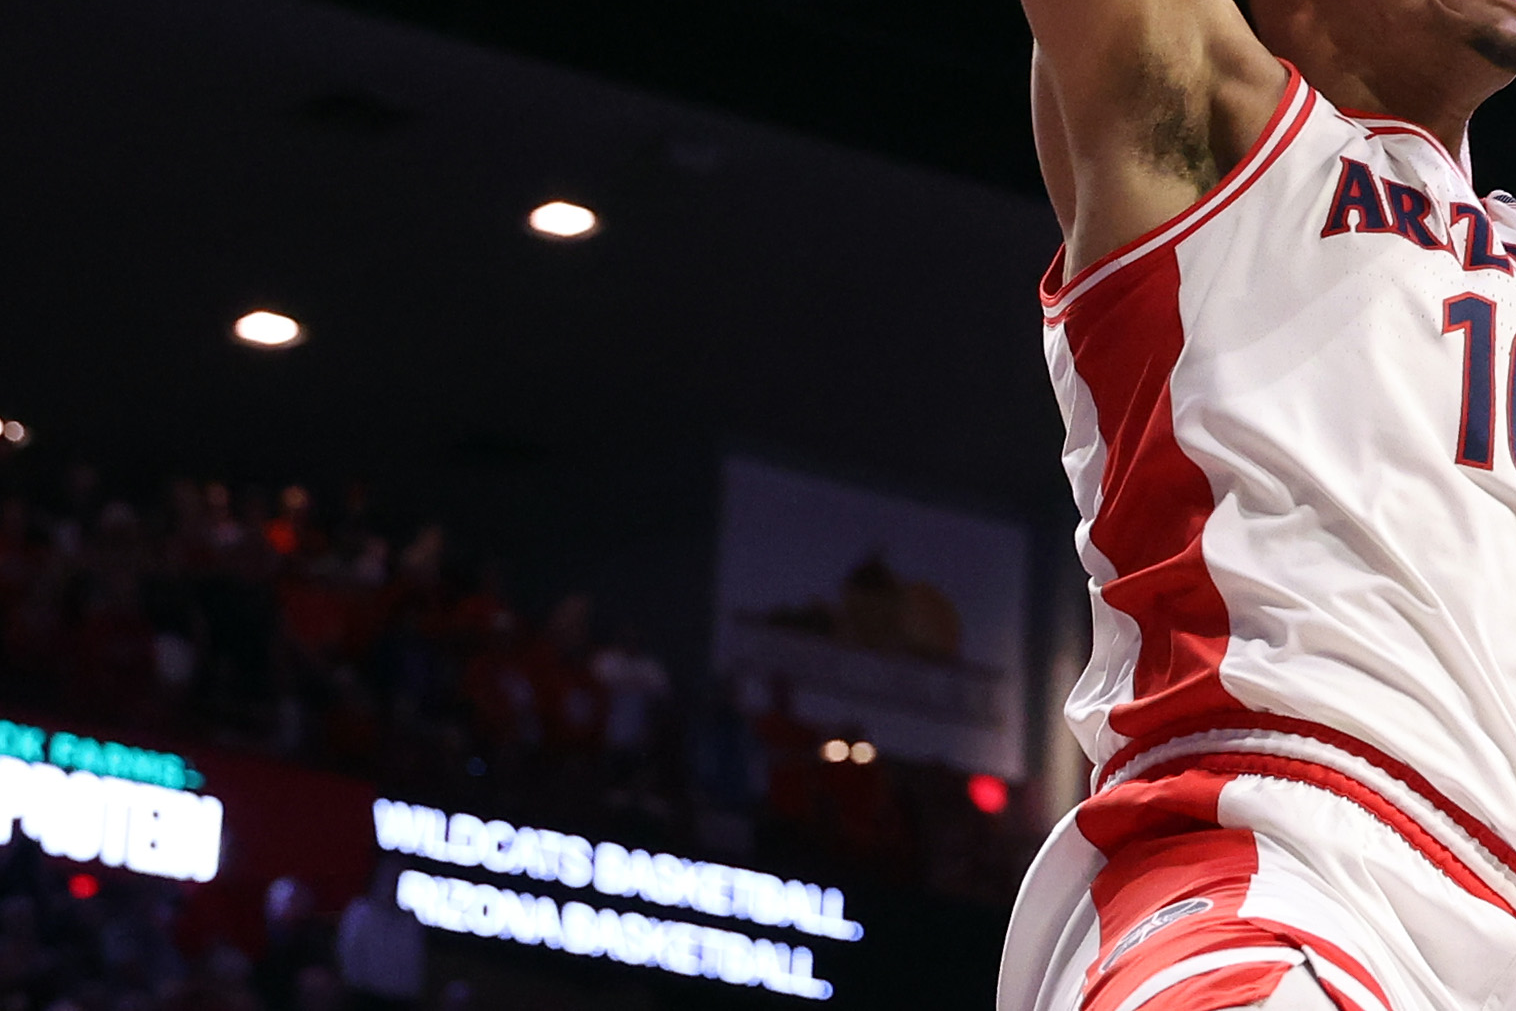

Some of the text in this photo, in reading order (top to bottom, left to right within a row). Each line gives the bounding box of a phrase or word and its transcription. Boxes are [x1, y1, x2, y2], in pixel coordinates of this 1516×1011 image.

[372, 798, 864, 941] WILDCATS BASKETBALL
[397, 870, 833, 1000] RIZONA BASKETBALL
